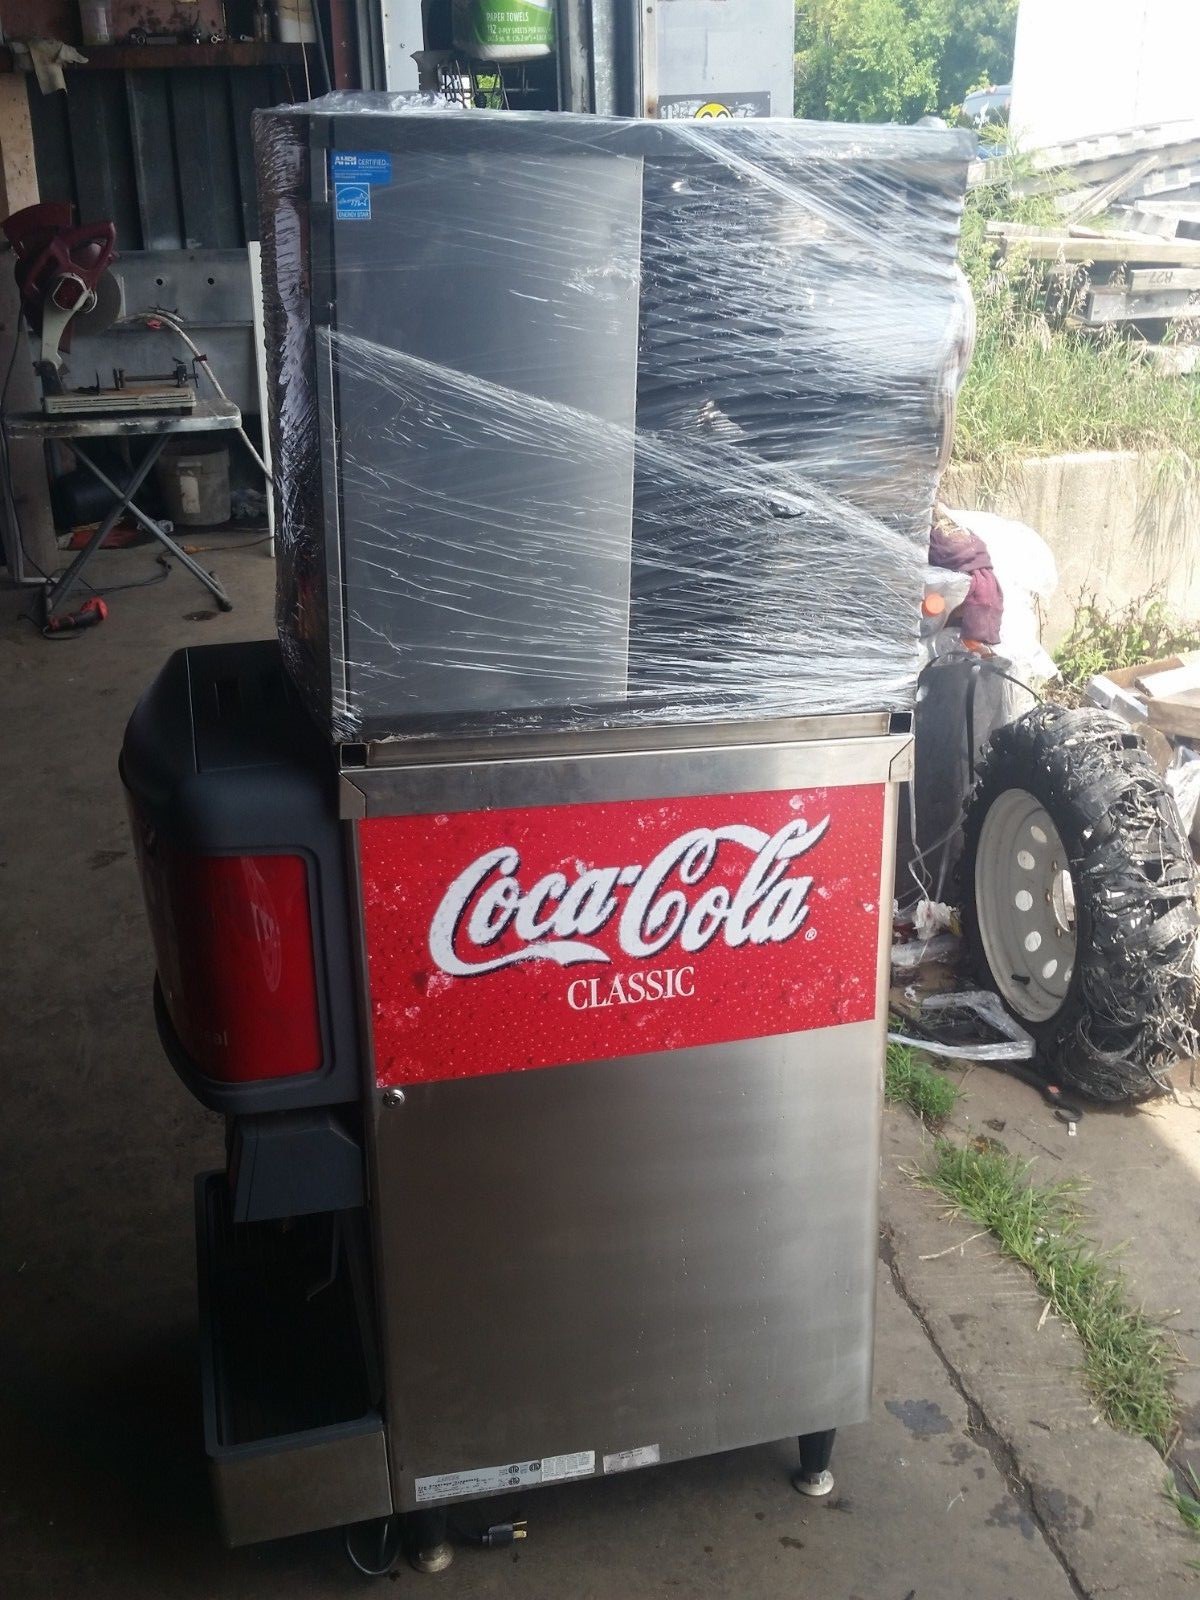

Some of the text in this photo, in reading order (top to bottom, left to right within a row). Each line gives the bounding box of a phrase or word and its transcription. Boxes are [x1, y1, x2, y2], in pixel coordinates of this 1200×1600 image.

[487, 12, 529, 22] PAPER TOWELS
[335, 156, 387, 166] AHRI CERTIFIED
[428, 813, 831, 977] Coca-Cola
[566, 966, 696, 1011] CLASSIC
